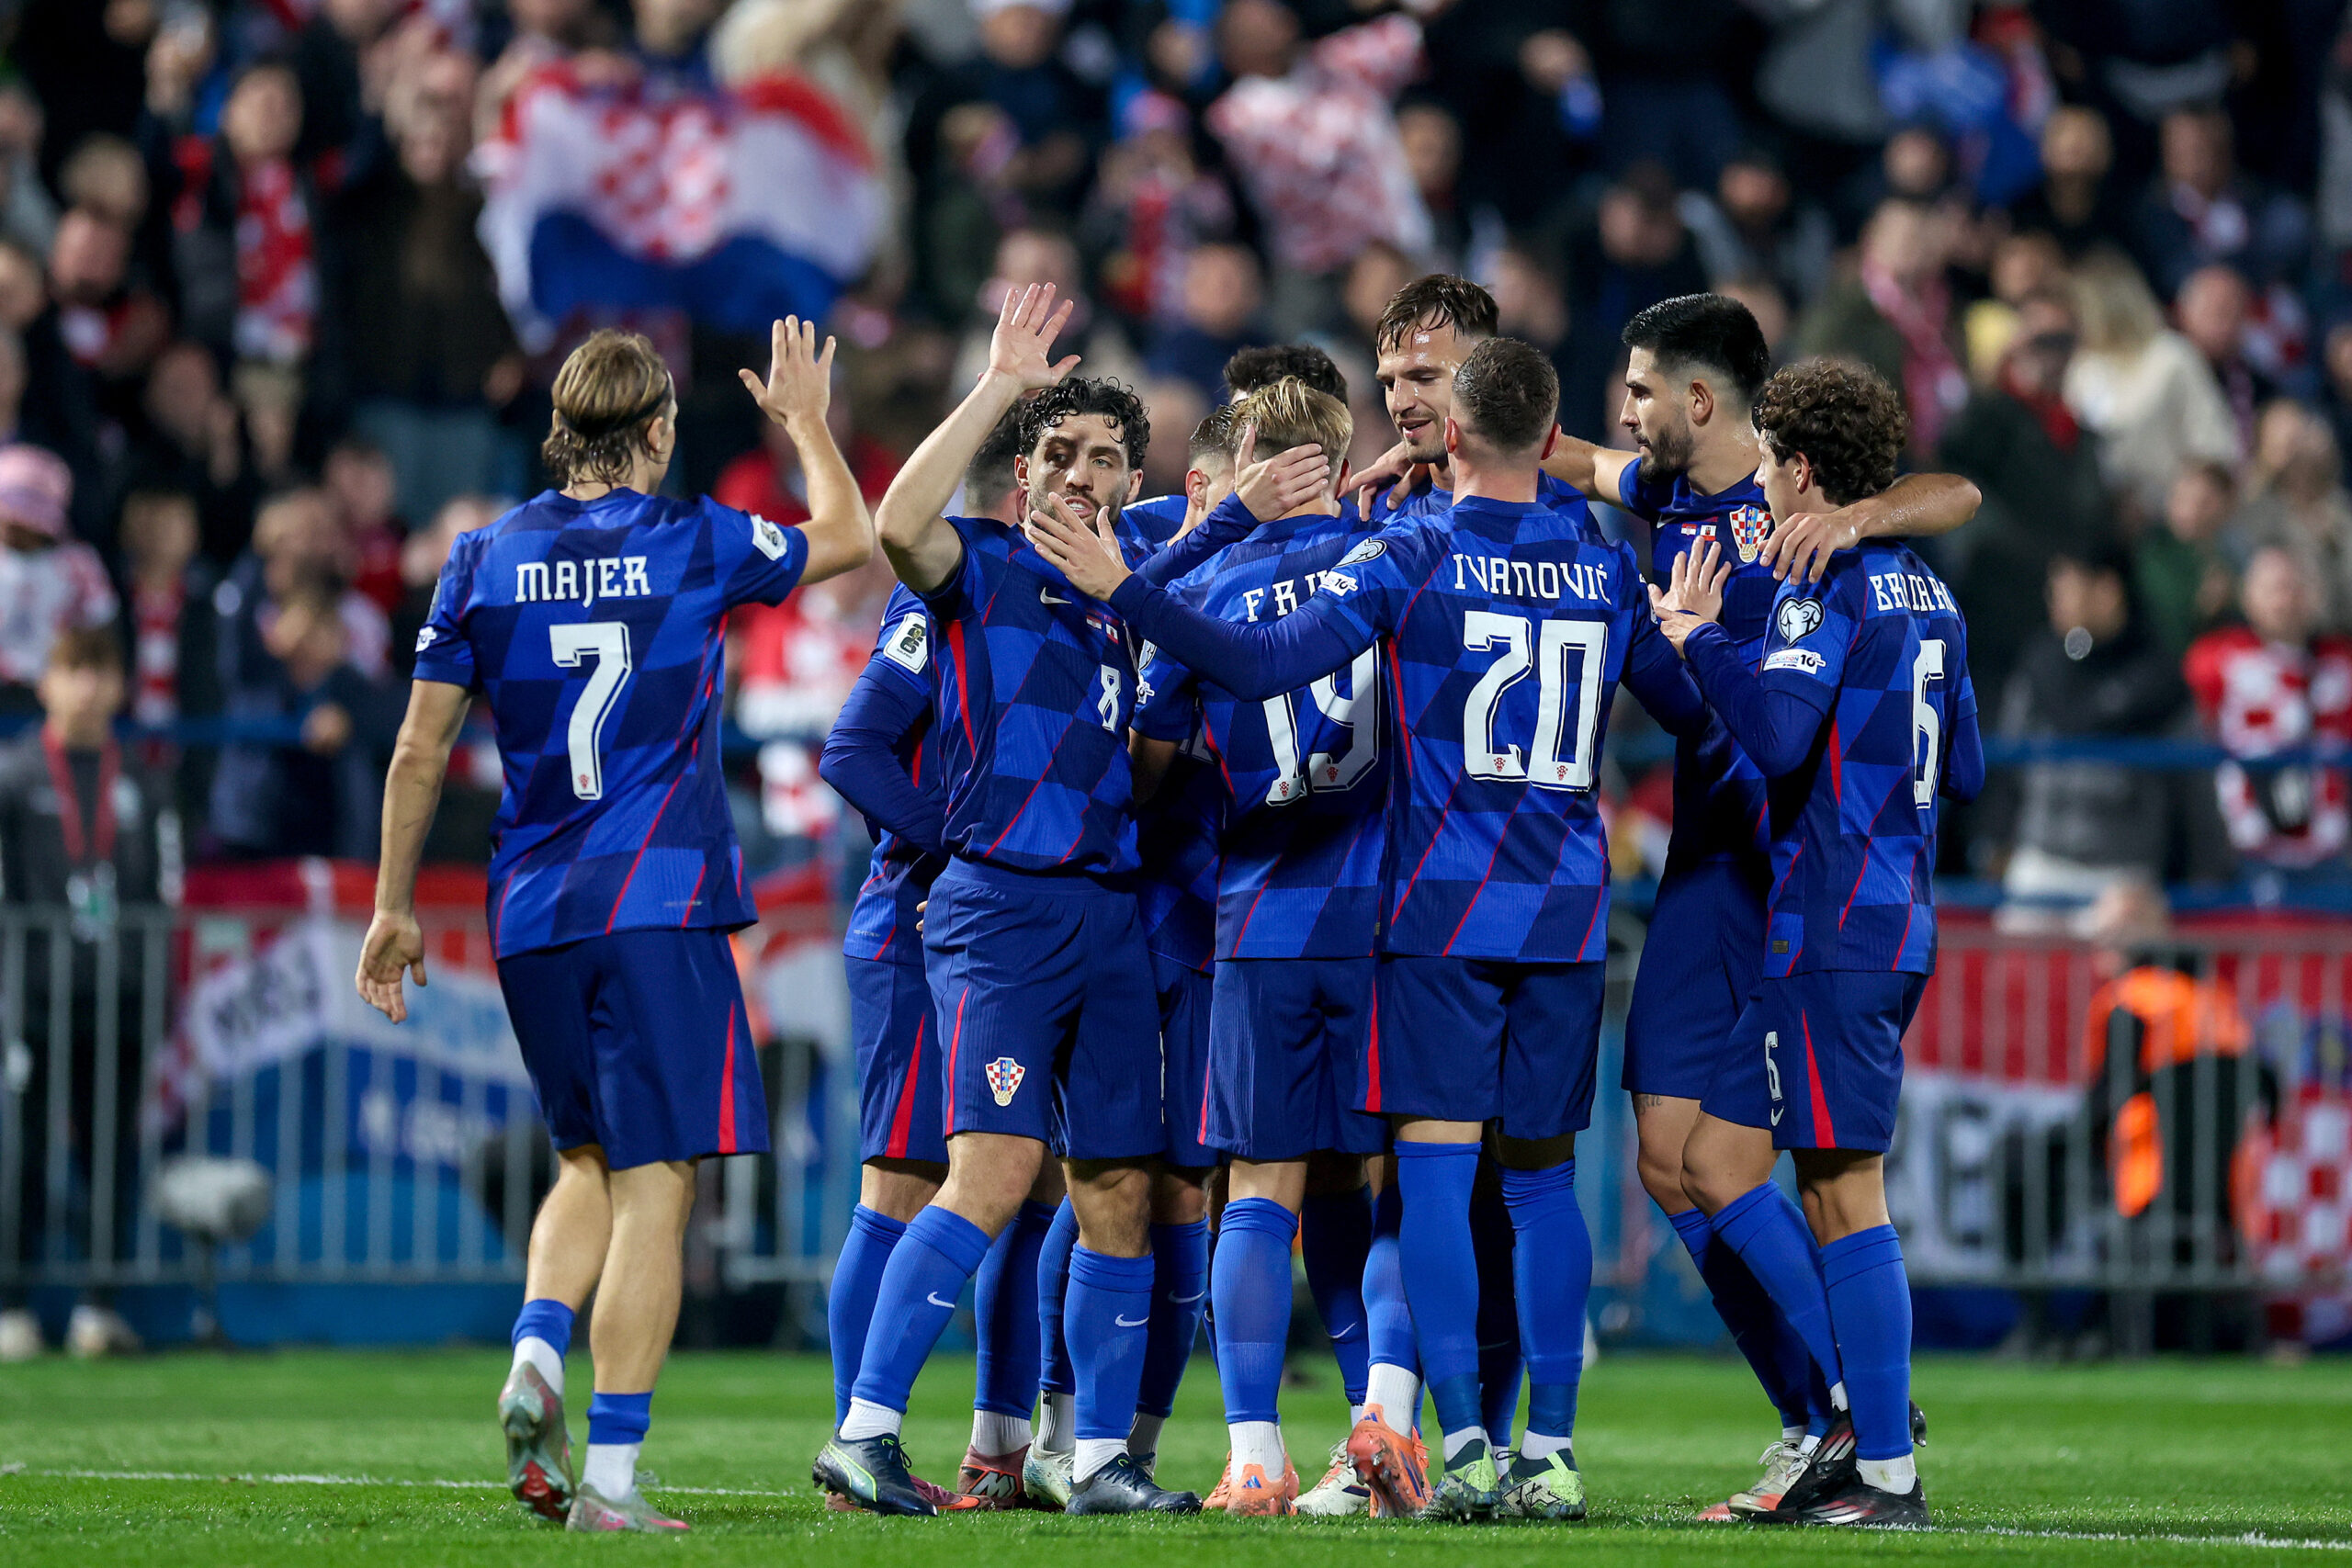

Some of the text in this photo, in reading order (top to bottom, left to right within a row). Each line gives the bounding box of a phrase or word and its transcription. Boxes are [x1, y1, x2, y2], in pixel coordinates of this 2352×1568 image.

[515, 555, 651, 608] MAJER
[1453, 553, 1611, 605] IVANOVIĆ
[549, 621, 633, 800] 7
[1097, 664, 1122, 733] 8
[1261, 639, 1380, 807] 19
[1463, 610, 1609, 793] 20
[1912, 639, 1947, 809] 6
[1765, 1031, 1783, 1101] 6
